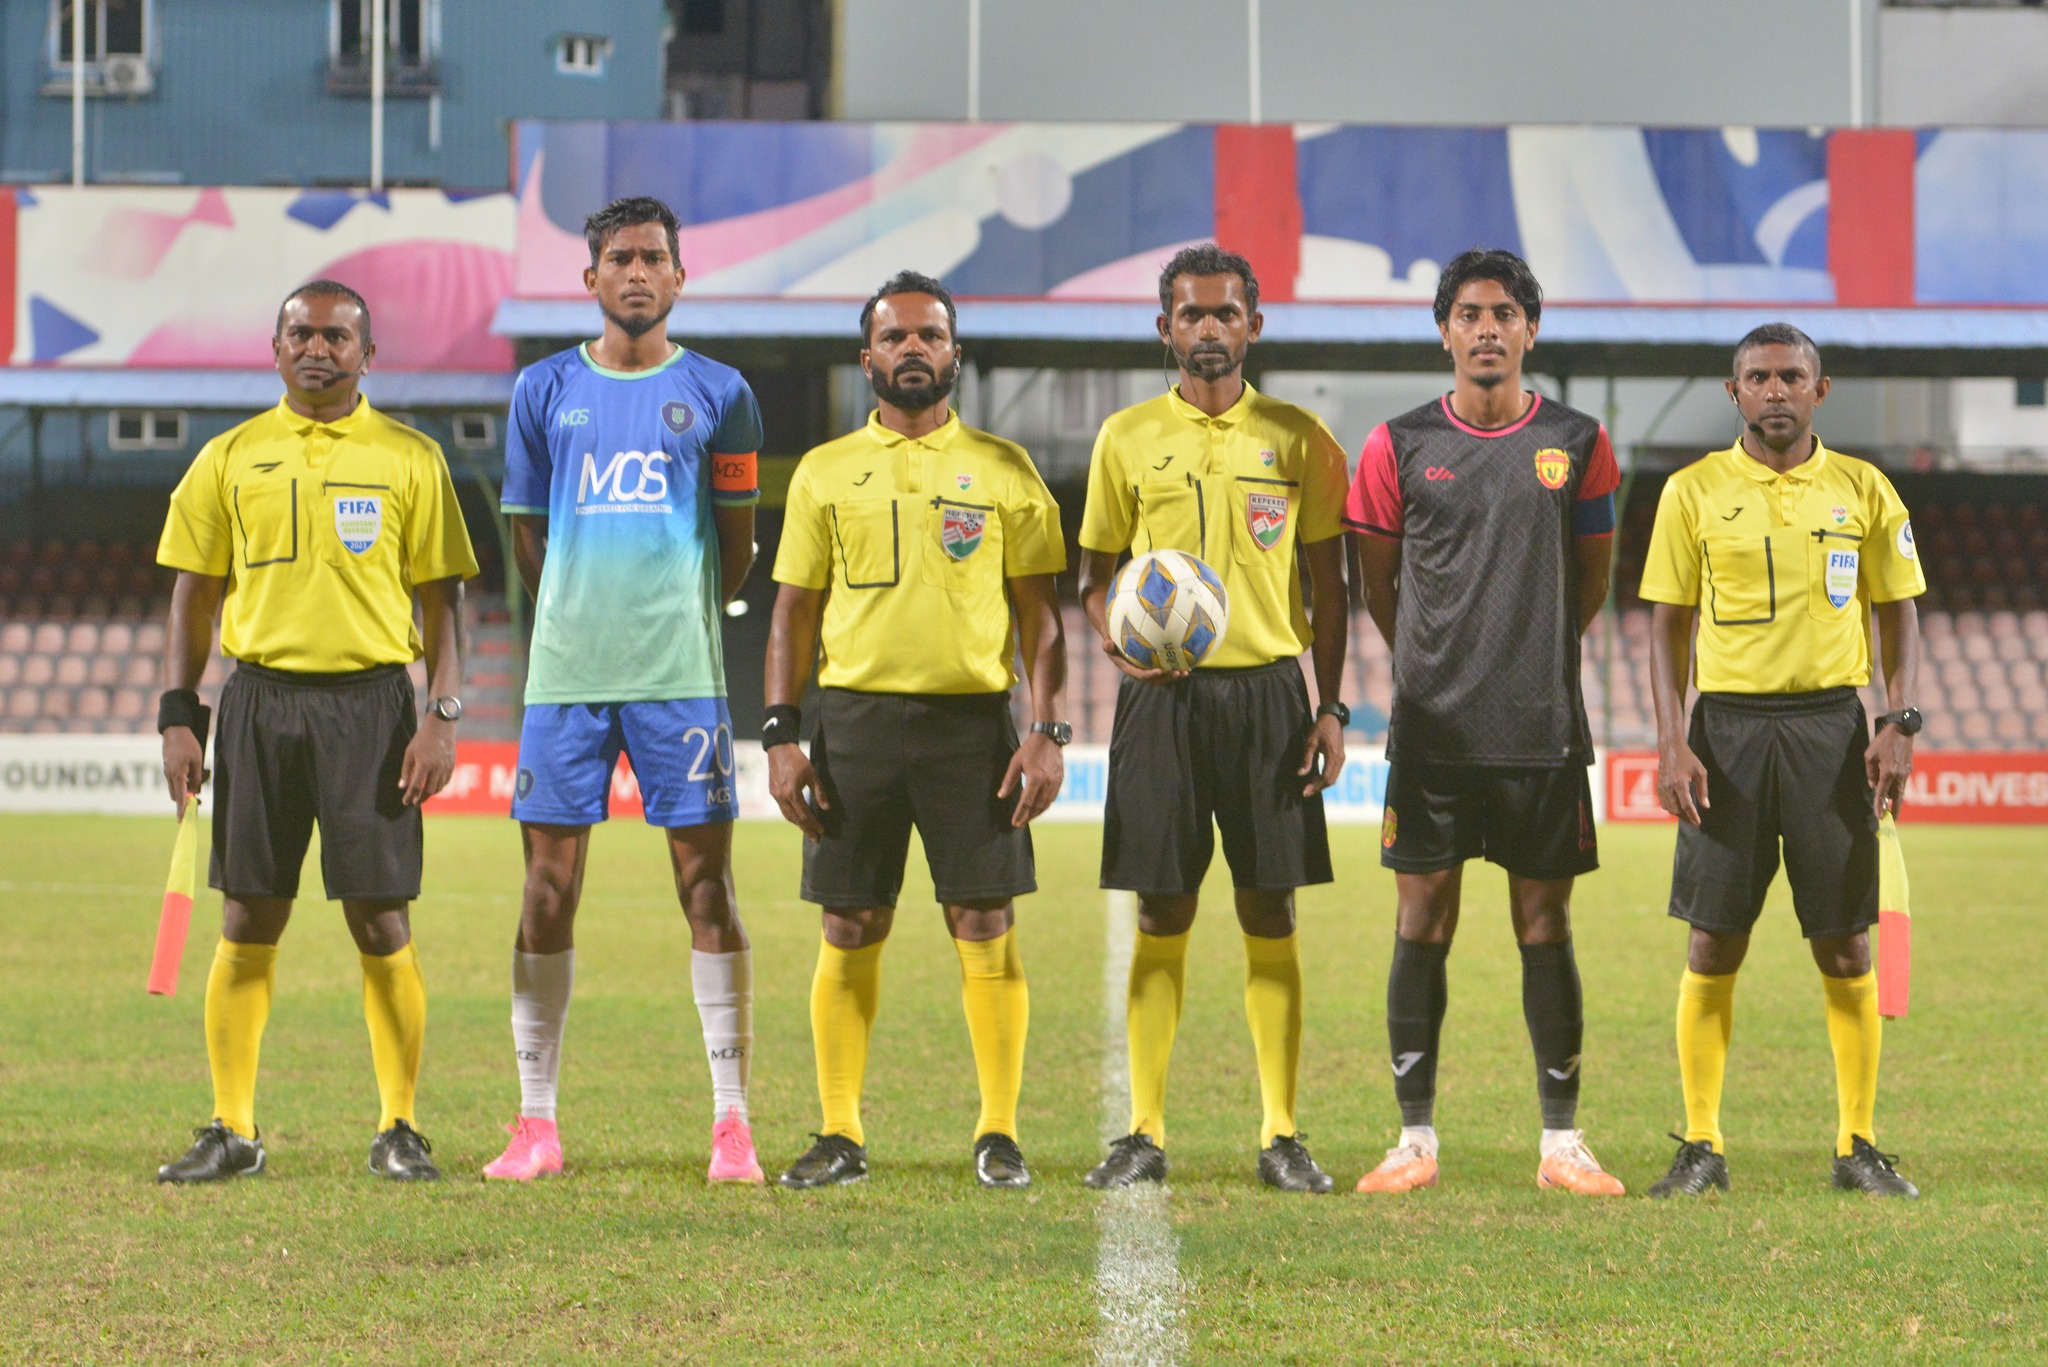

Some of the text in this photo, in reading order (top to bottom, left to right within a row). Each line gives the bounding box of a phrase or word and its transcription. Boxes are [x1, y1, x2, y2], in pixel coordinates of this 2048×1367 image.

[576, 450, 673, 504] MOS
[713, 461, 746, 479] MOS
[338, 501, 377, 514] FIFA
[1252, 495, 1286, 507] REFEREE
[1831, 553, 1856, 569] FIFA
[682, 722, 733, 782] 20
[0, 759, 212, 790] OUNDATI
[706, 785, 732, 806] MOS
[1902, 771, 2048, 807] ALDIVES
[516, 1050, 541, 1062] OS
[711, 1046, 745, 1061] MOS
